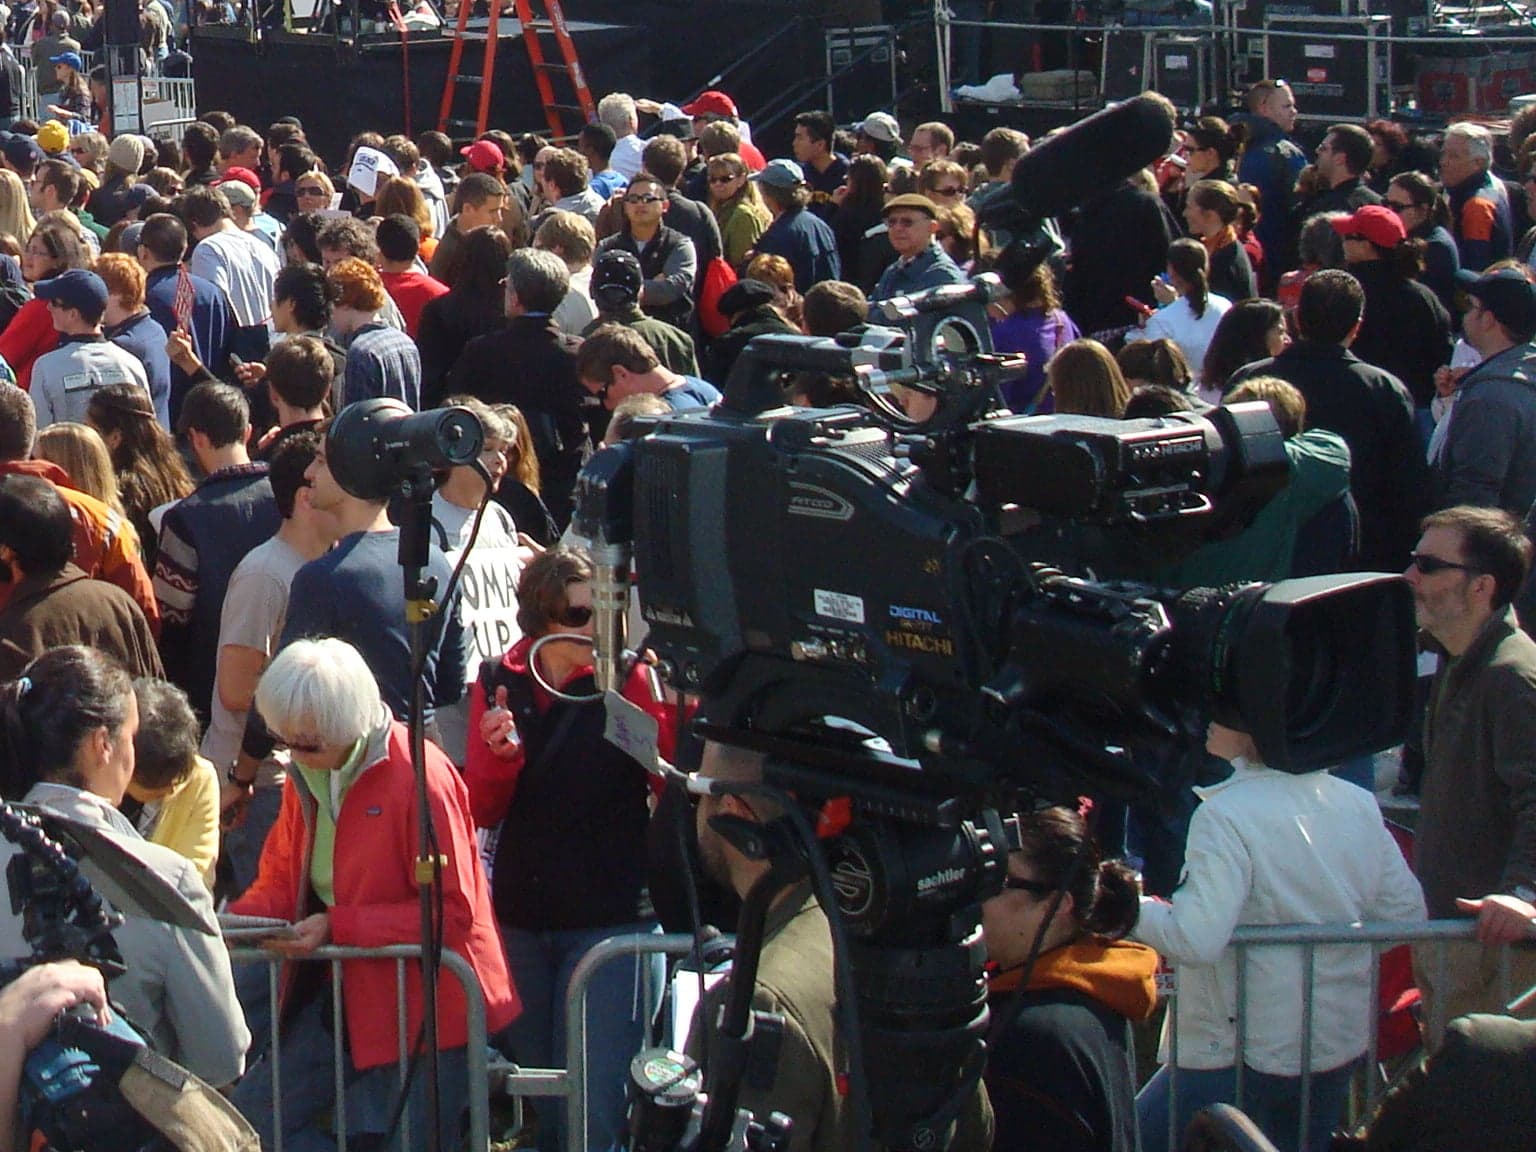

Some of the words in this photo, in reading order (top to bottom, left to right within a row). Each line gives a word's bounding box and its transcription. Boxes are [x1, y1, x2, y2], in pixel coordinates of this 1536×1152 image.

[889, 604, 942, 624] DIGITAL
[471, 619, 510, 661] UP
[885, 630, 954, 657] HITACHI
[917, 867, 966, 891] sachtler
